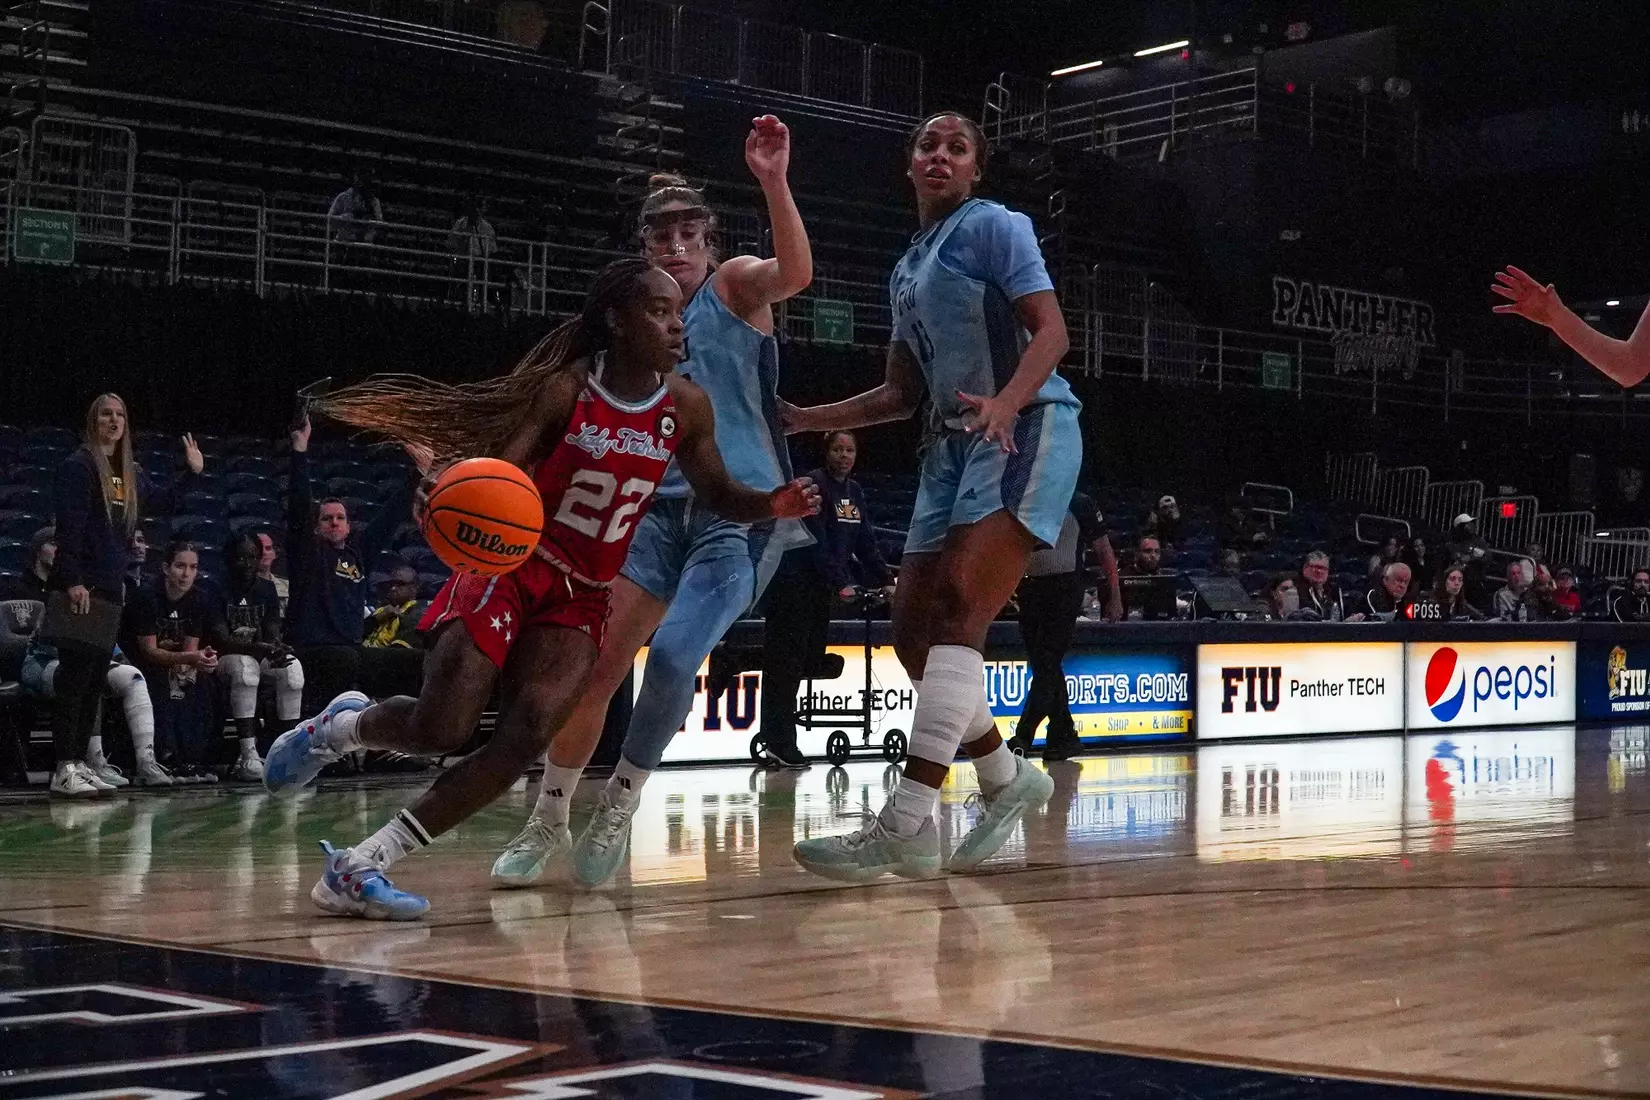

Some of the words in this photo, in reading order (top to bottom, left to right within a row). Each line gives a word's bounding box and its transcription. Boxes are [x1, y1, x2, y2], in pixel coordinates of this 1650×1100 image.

[1273, 276, 1436, 347] PANTHER
[565, 422, 611, 459] Lady
[553, 468, 655, 543] 22
[456, 520, 528, 556] Wilson
[1221, 666, 1282, 713] FIU
[1290, 679, 1344, 697] Panther
[1347, 677, 1385, 696] TECH
[1473, 654, 1556, 712] pepsi
[1619, 669, 1647, 697] FIU
